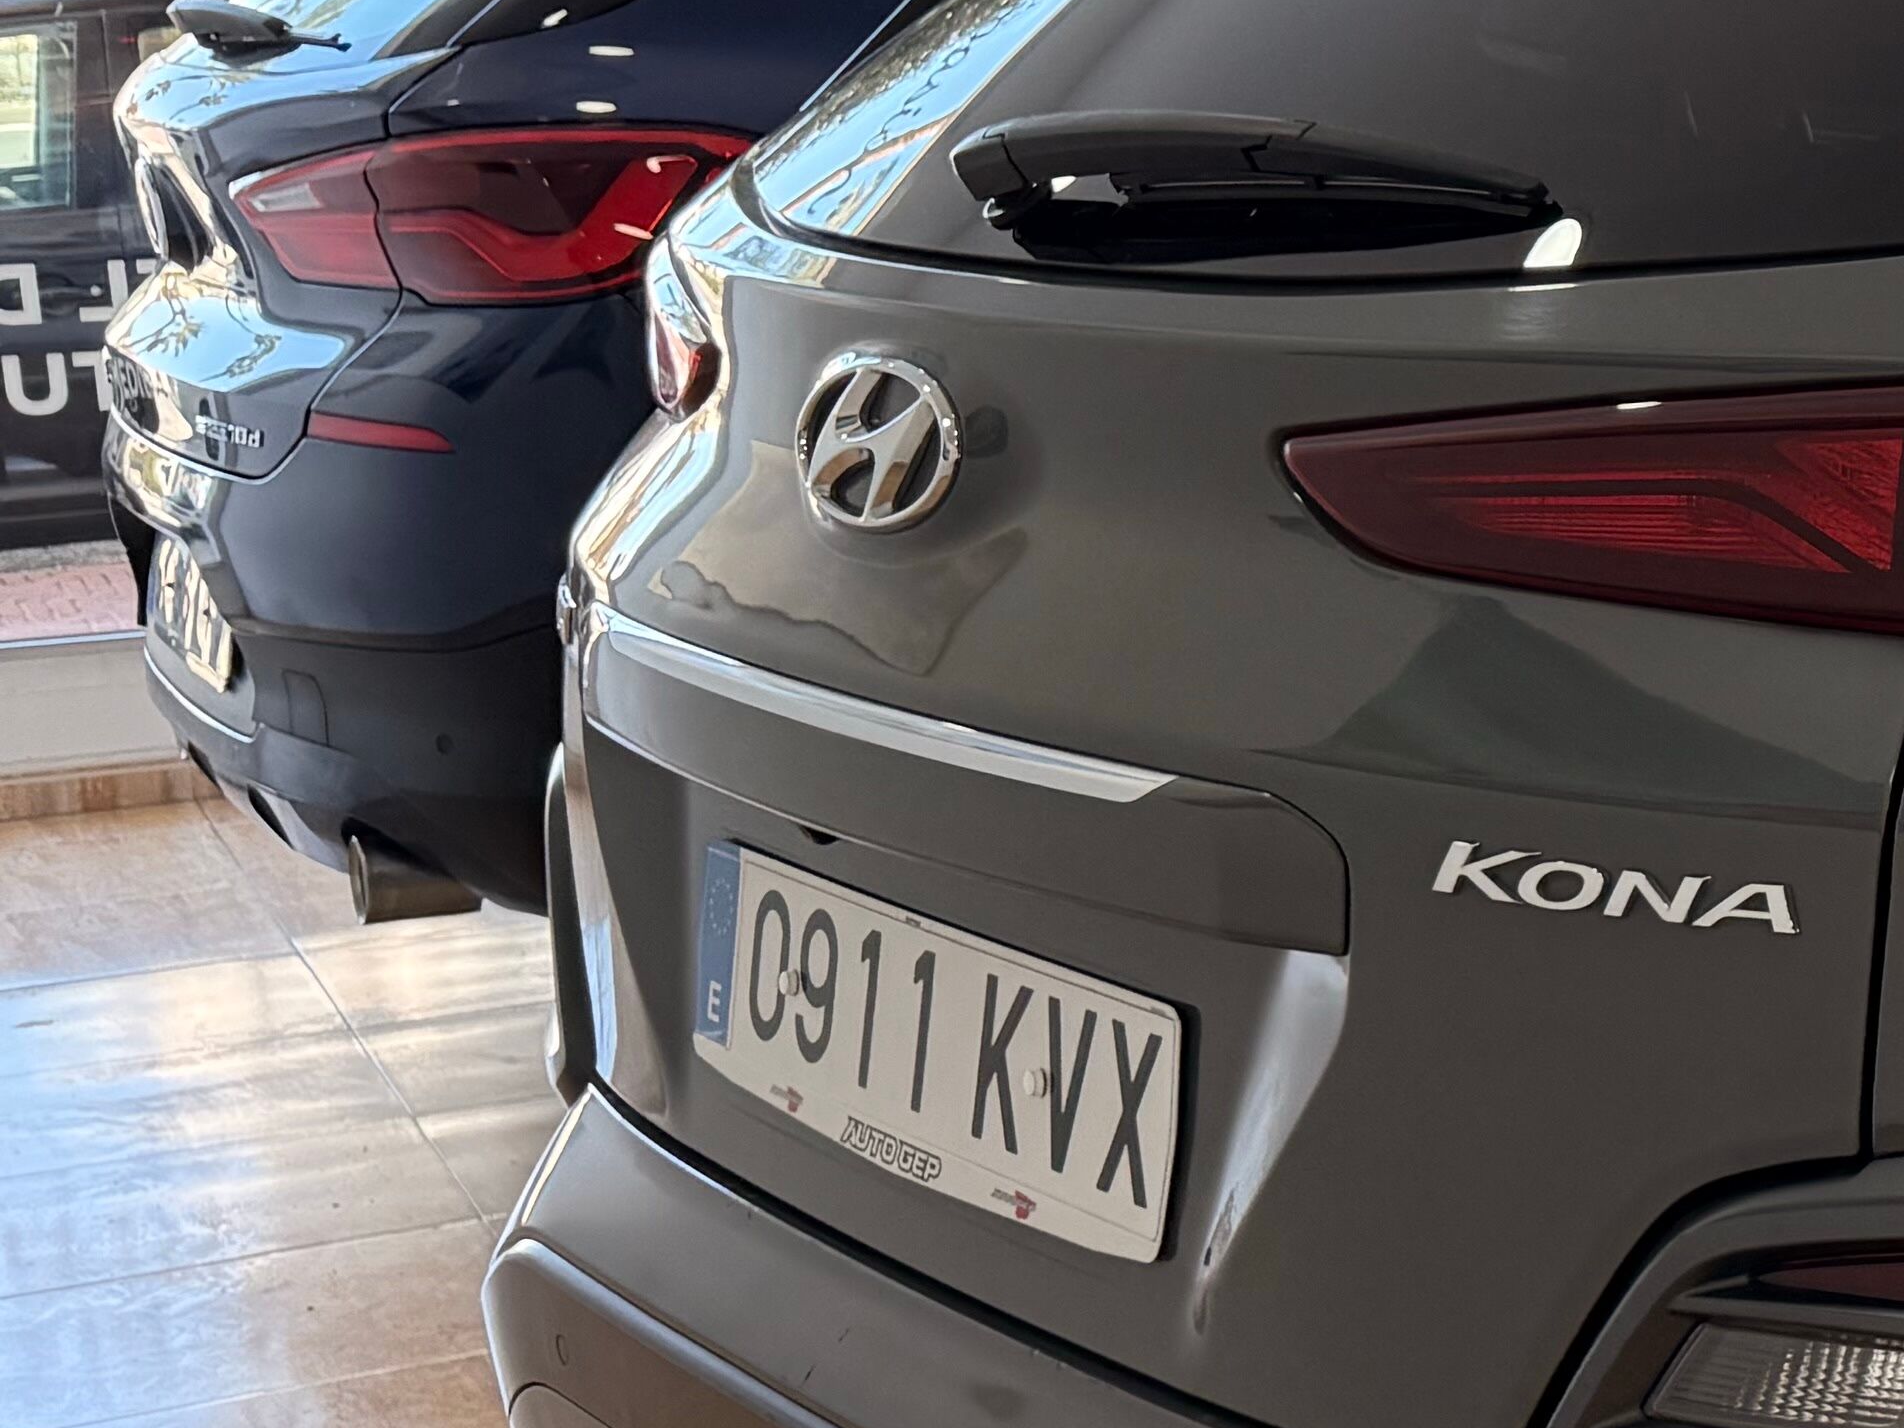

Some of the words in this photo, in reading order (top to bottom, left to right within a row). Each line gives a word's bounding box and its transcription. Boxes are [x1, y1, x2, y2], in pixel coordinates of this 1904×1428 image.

[1431, 839, 1801, 936] KONA
[705, 979, 723, 1024] E
[748, 888, 936, 1114] 0911
[971, 972, 1163, 1210] KVX
